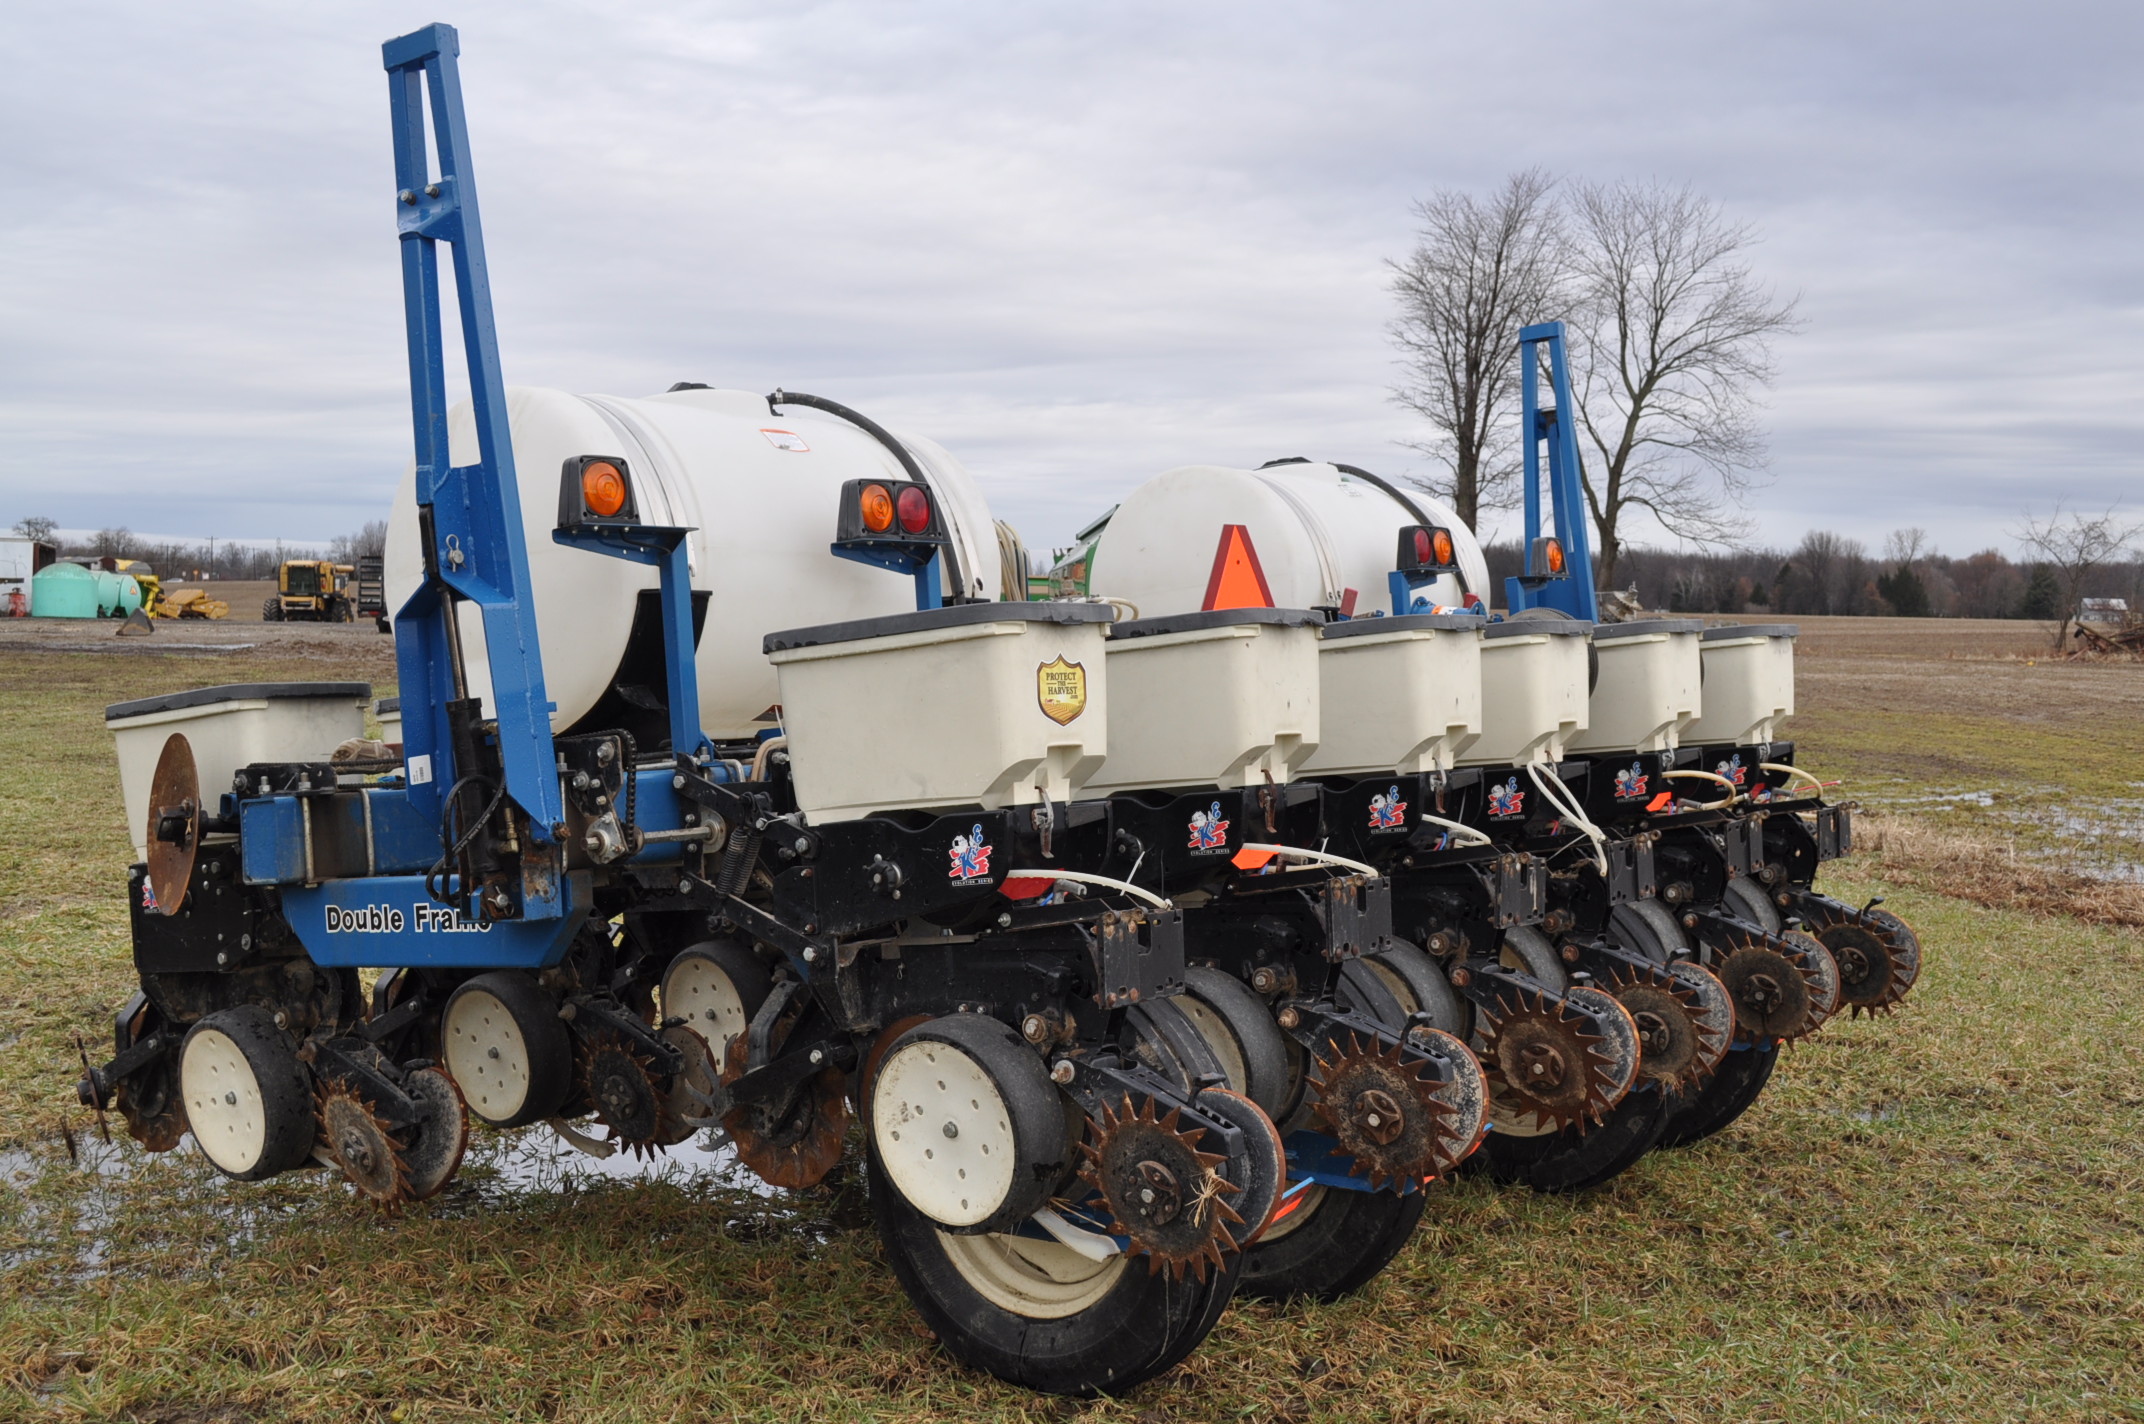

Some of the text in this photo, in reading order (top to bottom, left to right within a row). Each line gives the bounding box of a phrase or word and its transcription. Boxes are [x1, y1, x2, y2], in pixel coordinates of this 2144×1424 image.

[1046, 672, 1076, 681] PROTECT
[1047, 686, 1078, 695] HARVEST
[325, 904, 404, 933] Double
